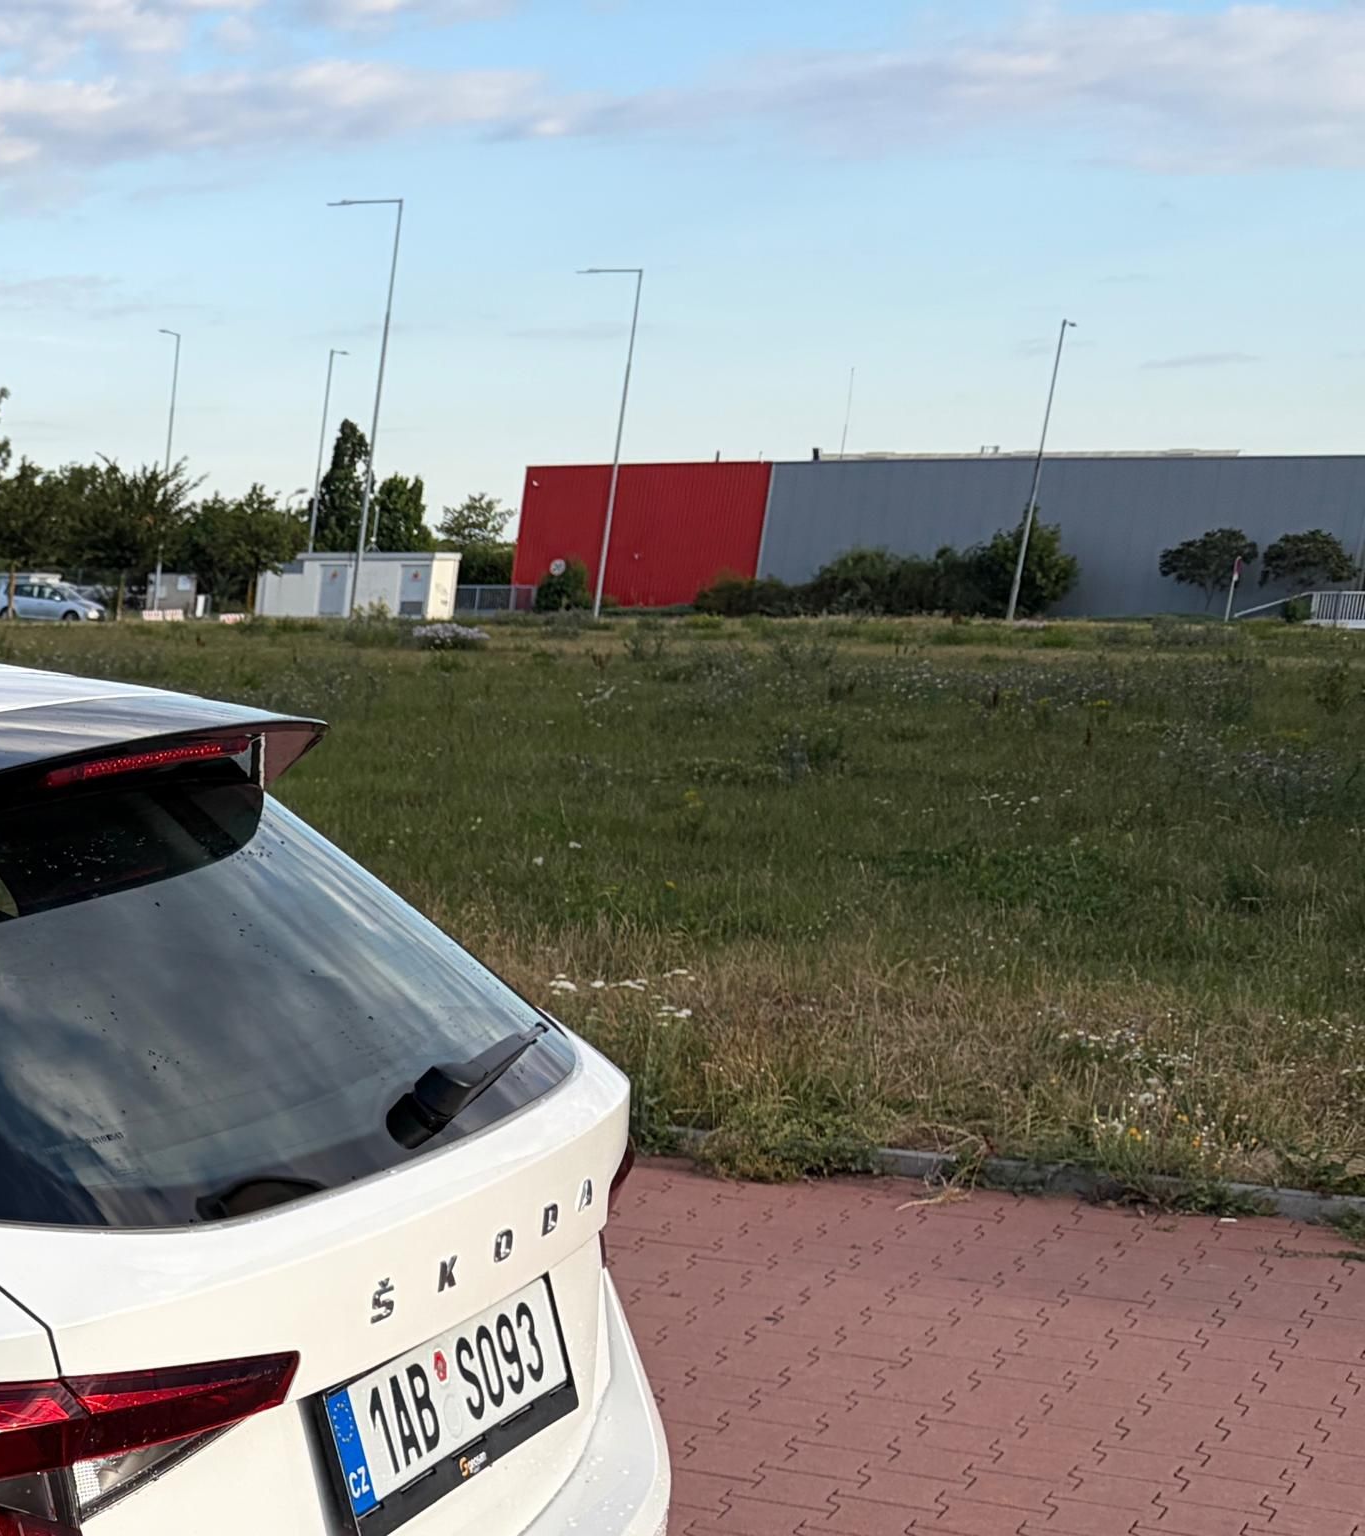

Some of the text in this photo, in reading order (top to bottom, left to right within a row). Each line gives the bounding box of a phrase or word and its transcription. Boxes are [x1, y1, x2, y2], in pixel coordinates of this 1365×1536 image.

[370, 1178, 594, 1325] ŠKODA
[369, 1301, 545, 1475] 1AB S093
[348, 1467, 371, 1499] CZ
